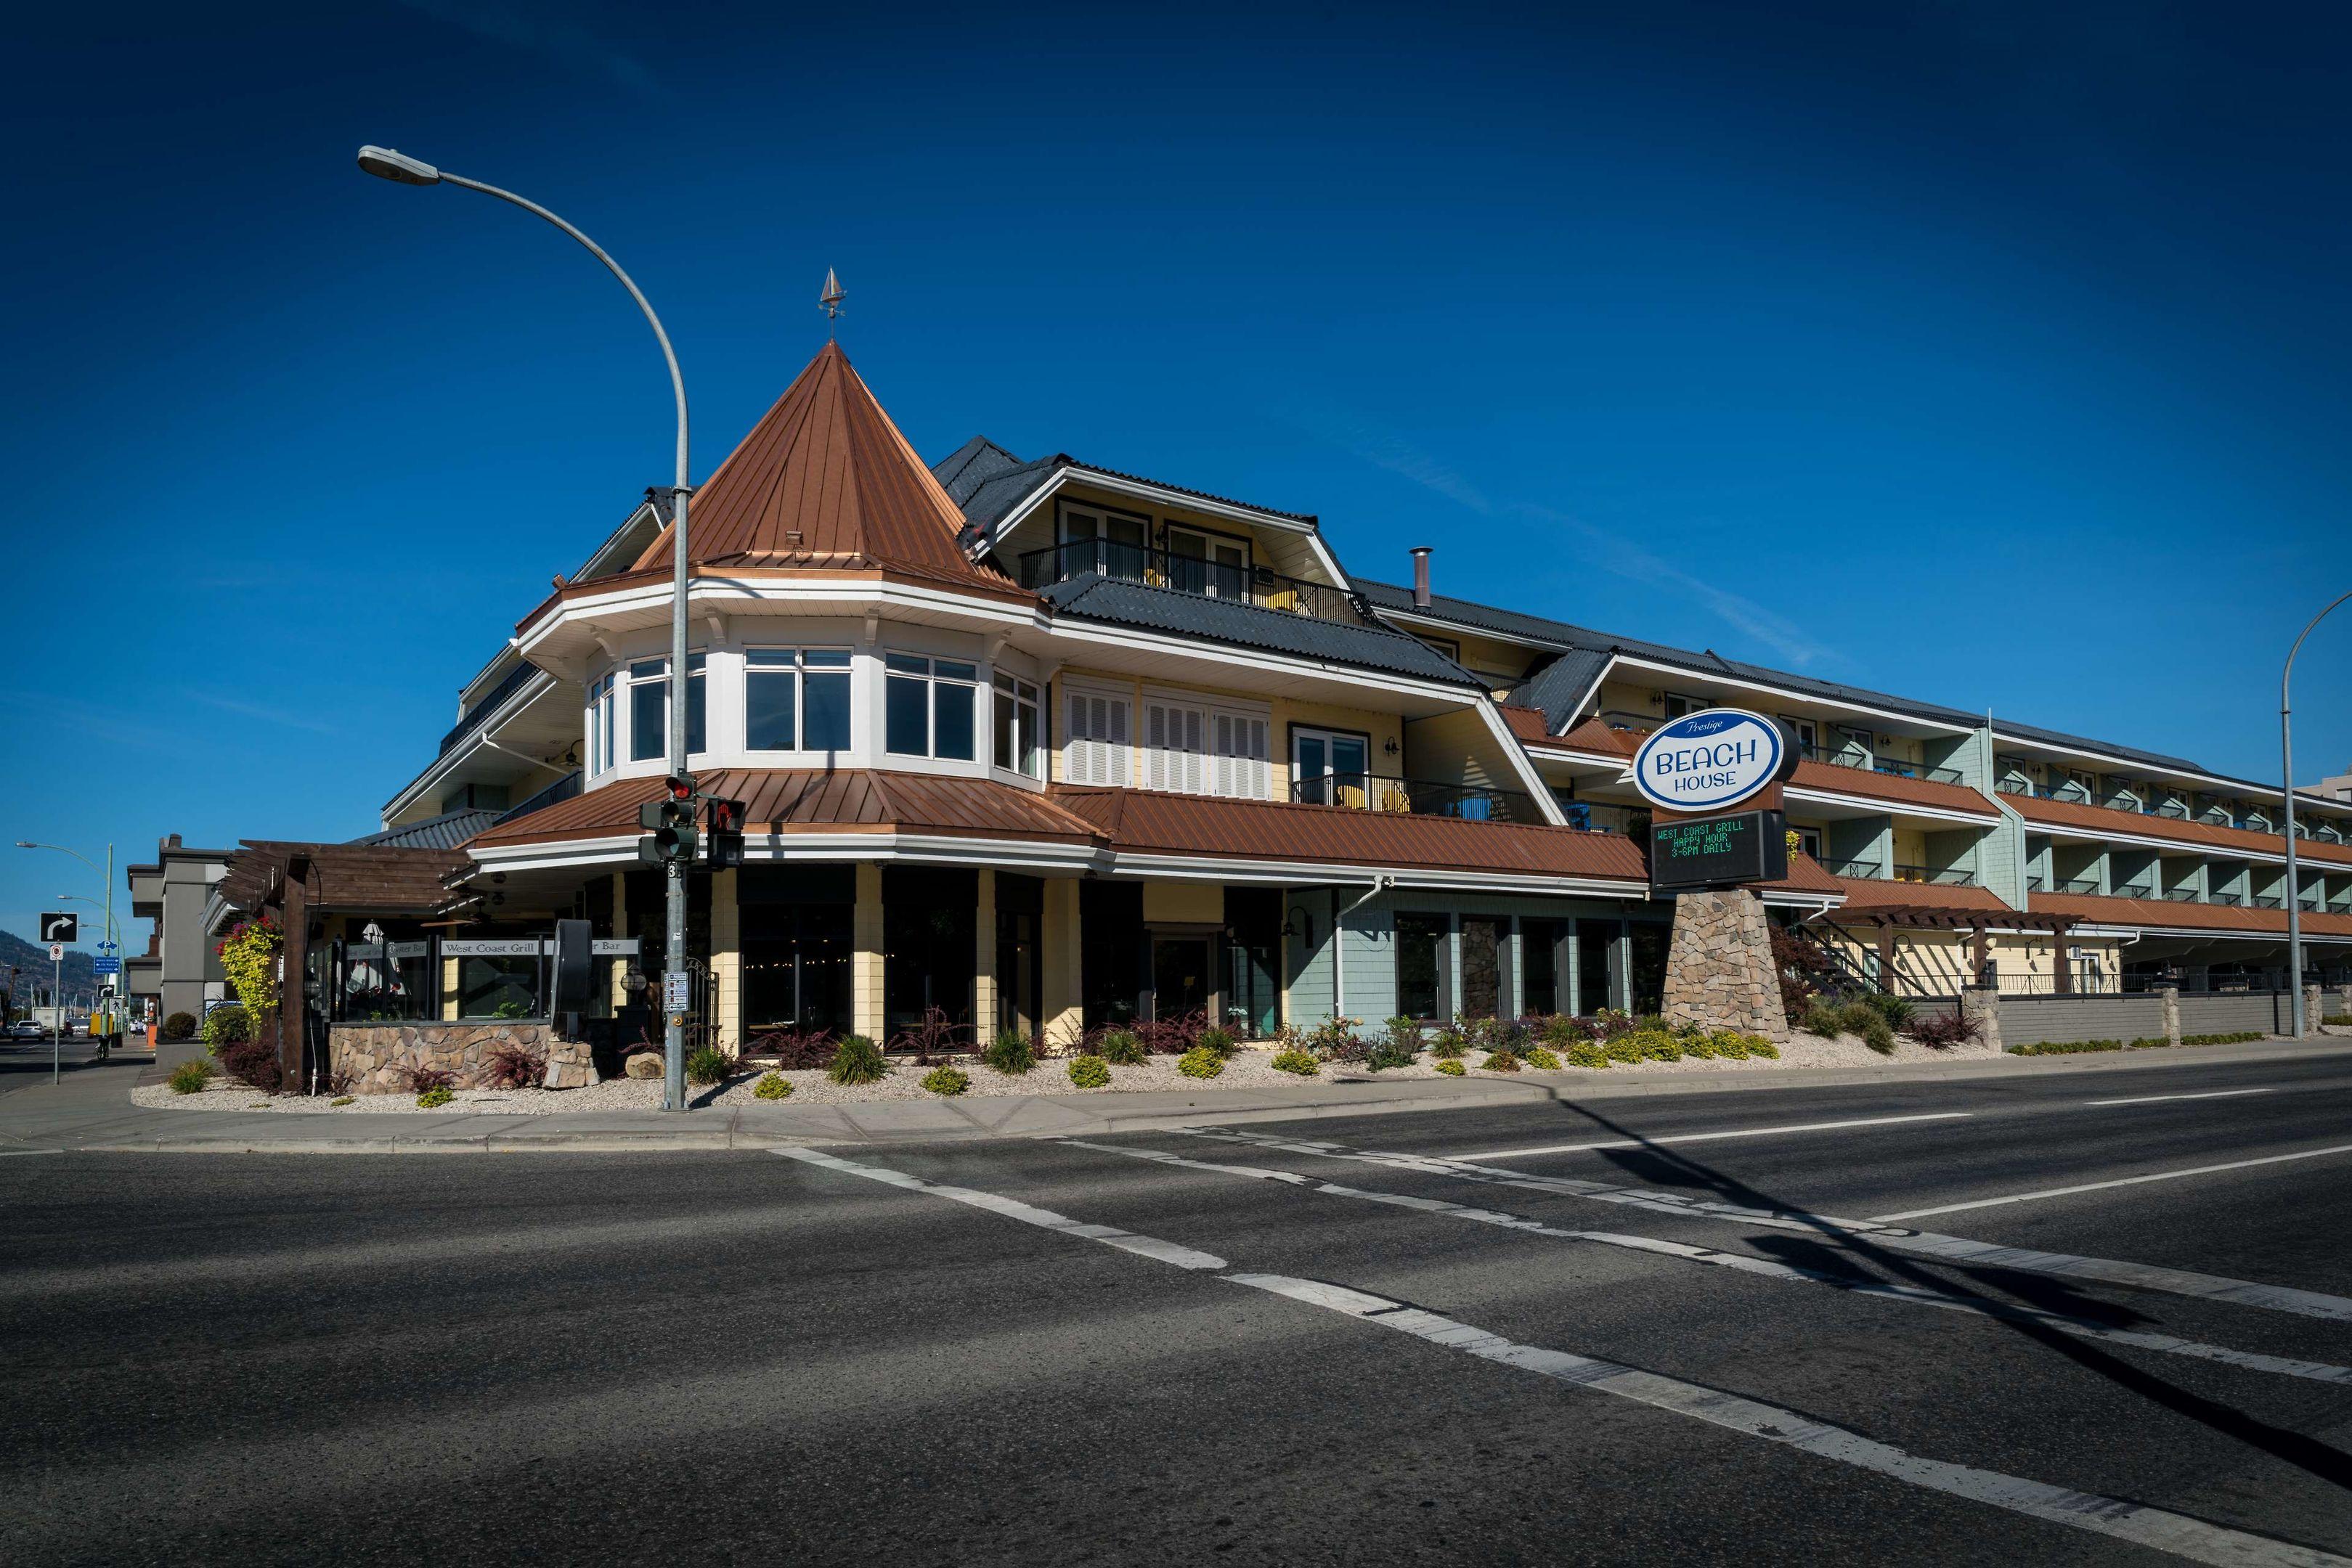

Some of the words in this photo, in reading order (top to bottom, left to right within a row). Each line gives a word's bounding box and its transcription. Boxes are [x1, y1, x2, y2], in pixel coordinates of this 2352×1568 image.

[1685, 720, 1723, 734] Prestige
[1656, 739, 1756, 775] BEACH
[1675, 771, 1736, 792] HOUSE
[1657, 829, 1677, 841] WEST
[1684, 825, 1709, 836] COAST
[1716, 820, 1744, 833] GRILL
[1673, 836, 1700, 848] HAPPY
[1705, 833, 1728, 844] HOUR
[1672, 845, 1698, 857] 3-6PM
[1704, 841, 1731, 854] DAILY
[669, 865, 675, 878] 3
[413, 944, 425, 952] Bar
[445, 944, 472, 953] West
[476, 943, 508, 953] Coast
[510, 942, 534, 952] Grill
[602, 942, 621, 950] Bar
